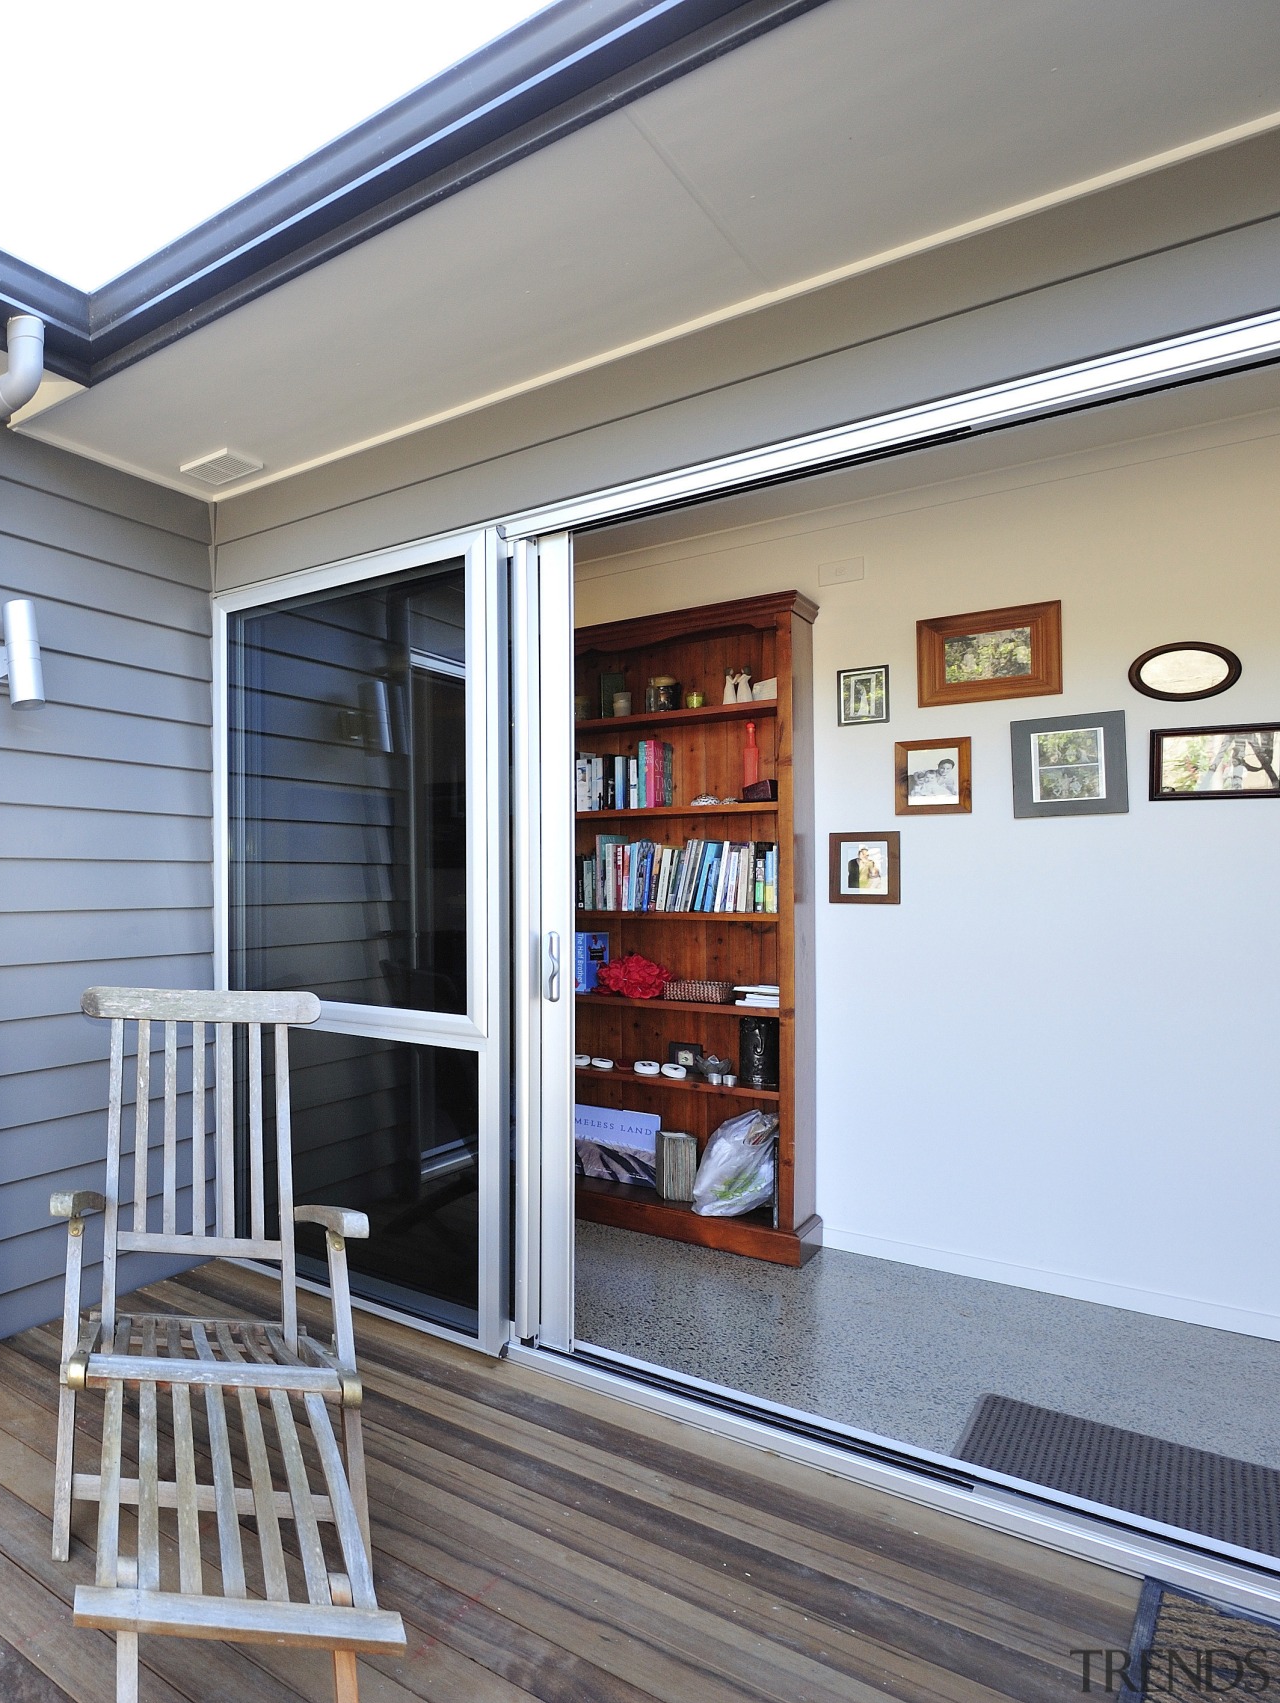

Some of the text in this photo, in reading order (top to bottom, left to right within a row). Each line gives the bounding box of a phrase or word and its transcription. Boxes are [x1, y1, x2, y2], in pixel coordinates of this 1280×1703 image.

[655, 759, 672, 774] SETH
[655, 775, 672, 791] TWO
[655, 791, 672, 804] LIVES
[620, 1124, 652, 1136] LAND
